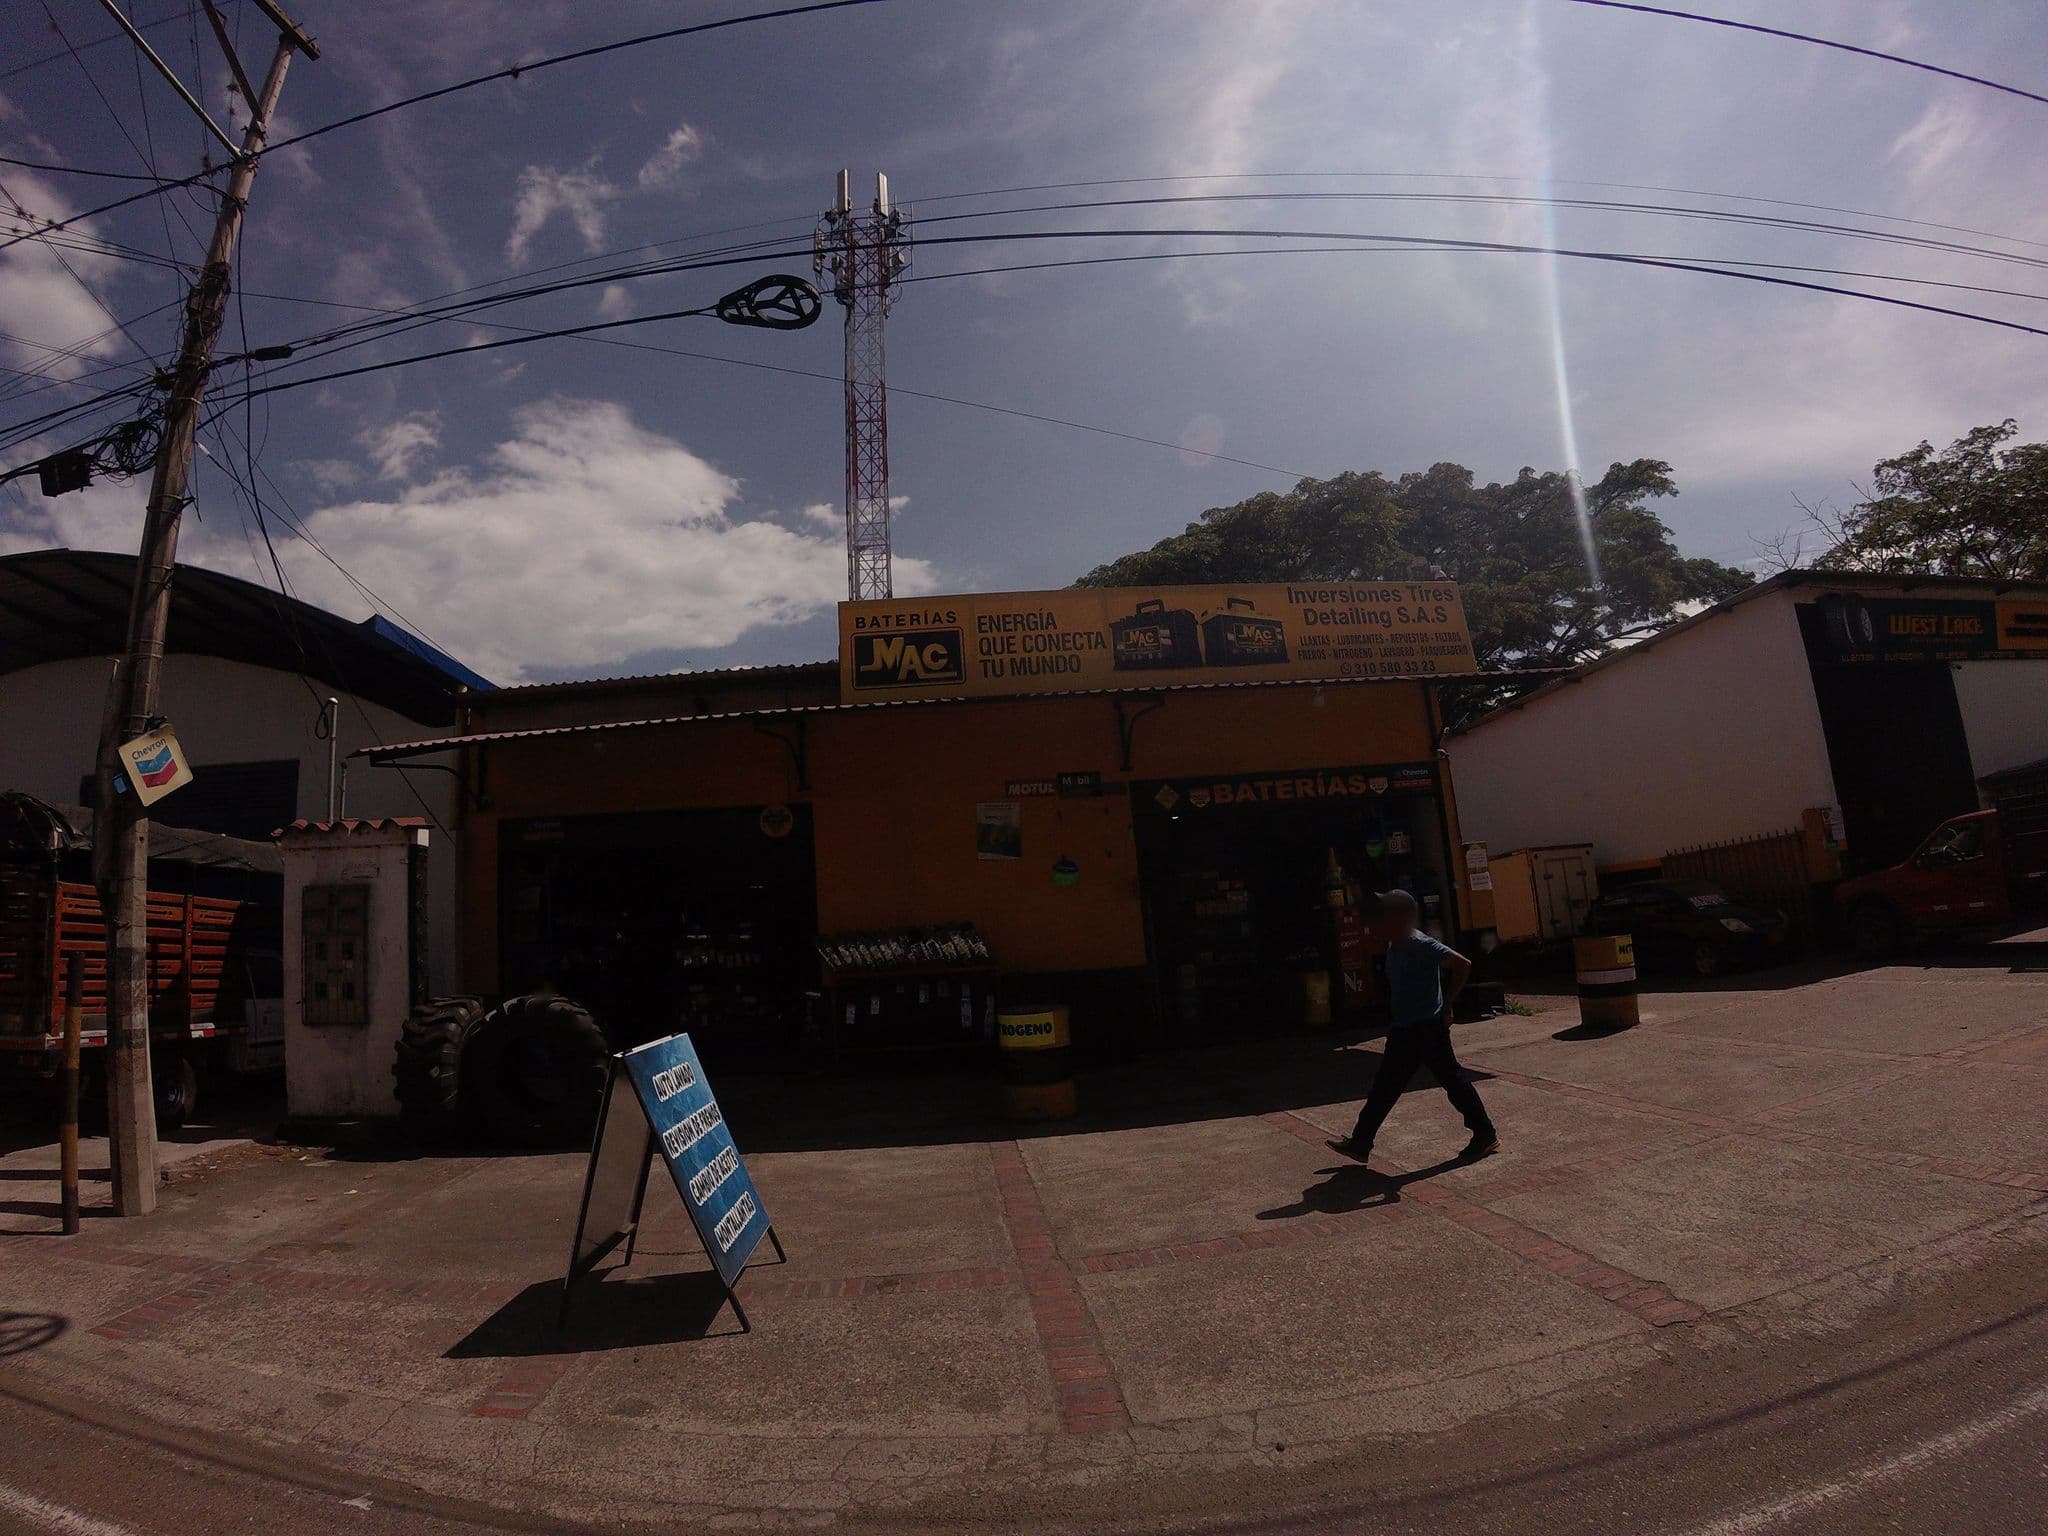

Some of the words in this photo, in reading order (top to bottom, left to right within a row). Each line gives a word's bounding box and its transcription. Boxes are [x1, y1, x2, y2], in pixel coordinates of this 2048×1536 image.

[1287, 585, 1400, 604] Inversiones
[1406, 585, 1454, 602] Tires
[854, 609, 957, 630] BATERÍAS
[977, 608, 1058, 634] ENERGÍA
[1303, 607, 1392, 628] Detailing
[978, 635, 1019, 657] QUE
[1022, 632, 1107, 654] CONECTA
[860, 636, 957, 681] MAC
[979, 658, 1009, 678] TU
[1010, 655, 1081, 677] MUNDO
[1355, 662, 1376, 675] 310
[1421, 660, 1436, 672] 23
[131, 738, 167, 760] Chevron
[1062, 776, 1090, 785] Mbil
[1212, 771, 1367, 804] BATERÍAS
[1000, 1022, 1052, 1037] ROGENO
[654, 1071, 675, 1098] AUTO
